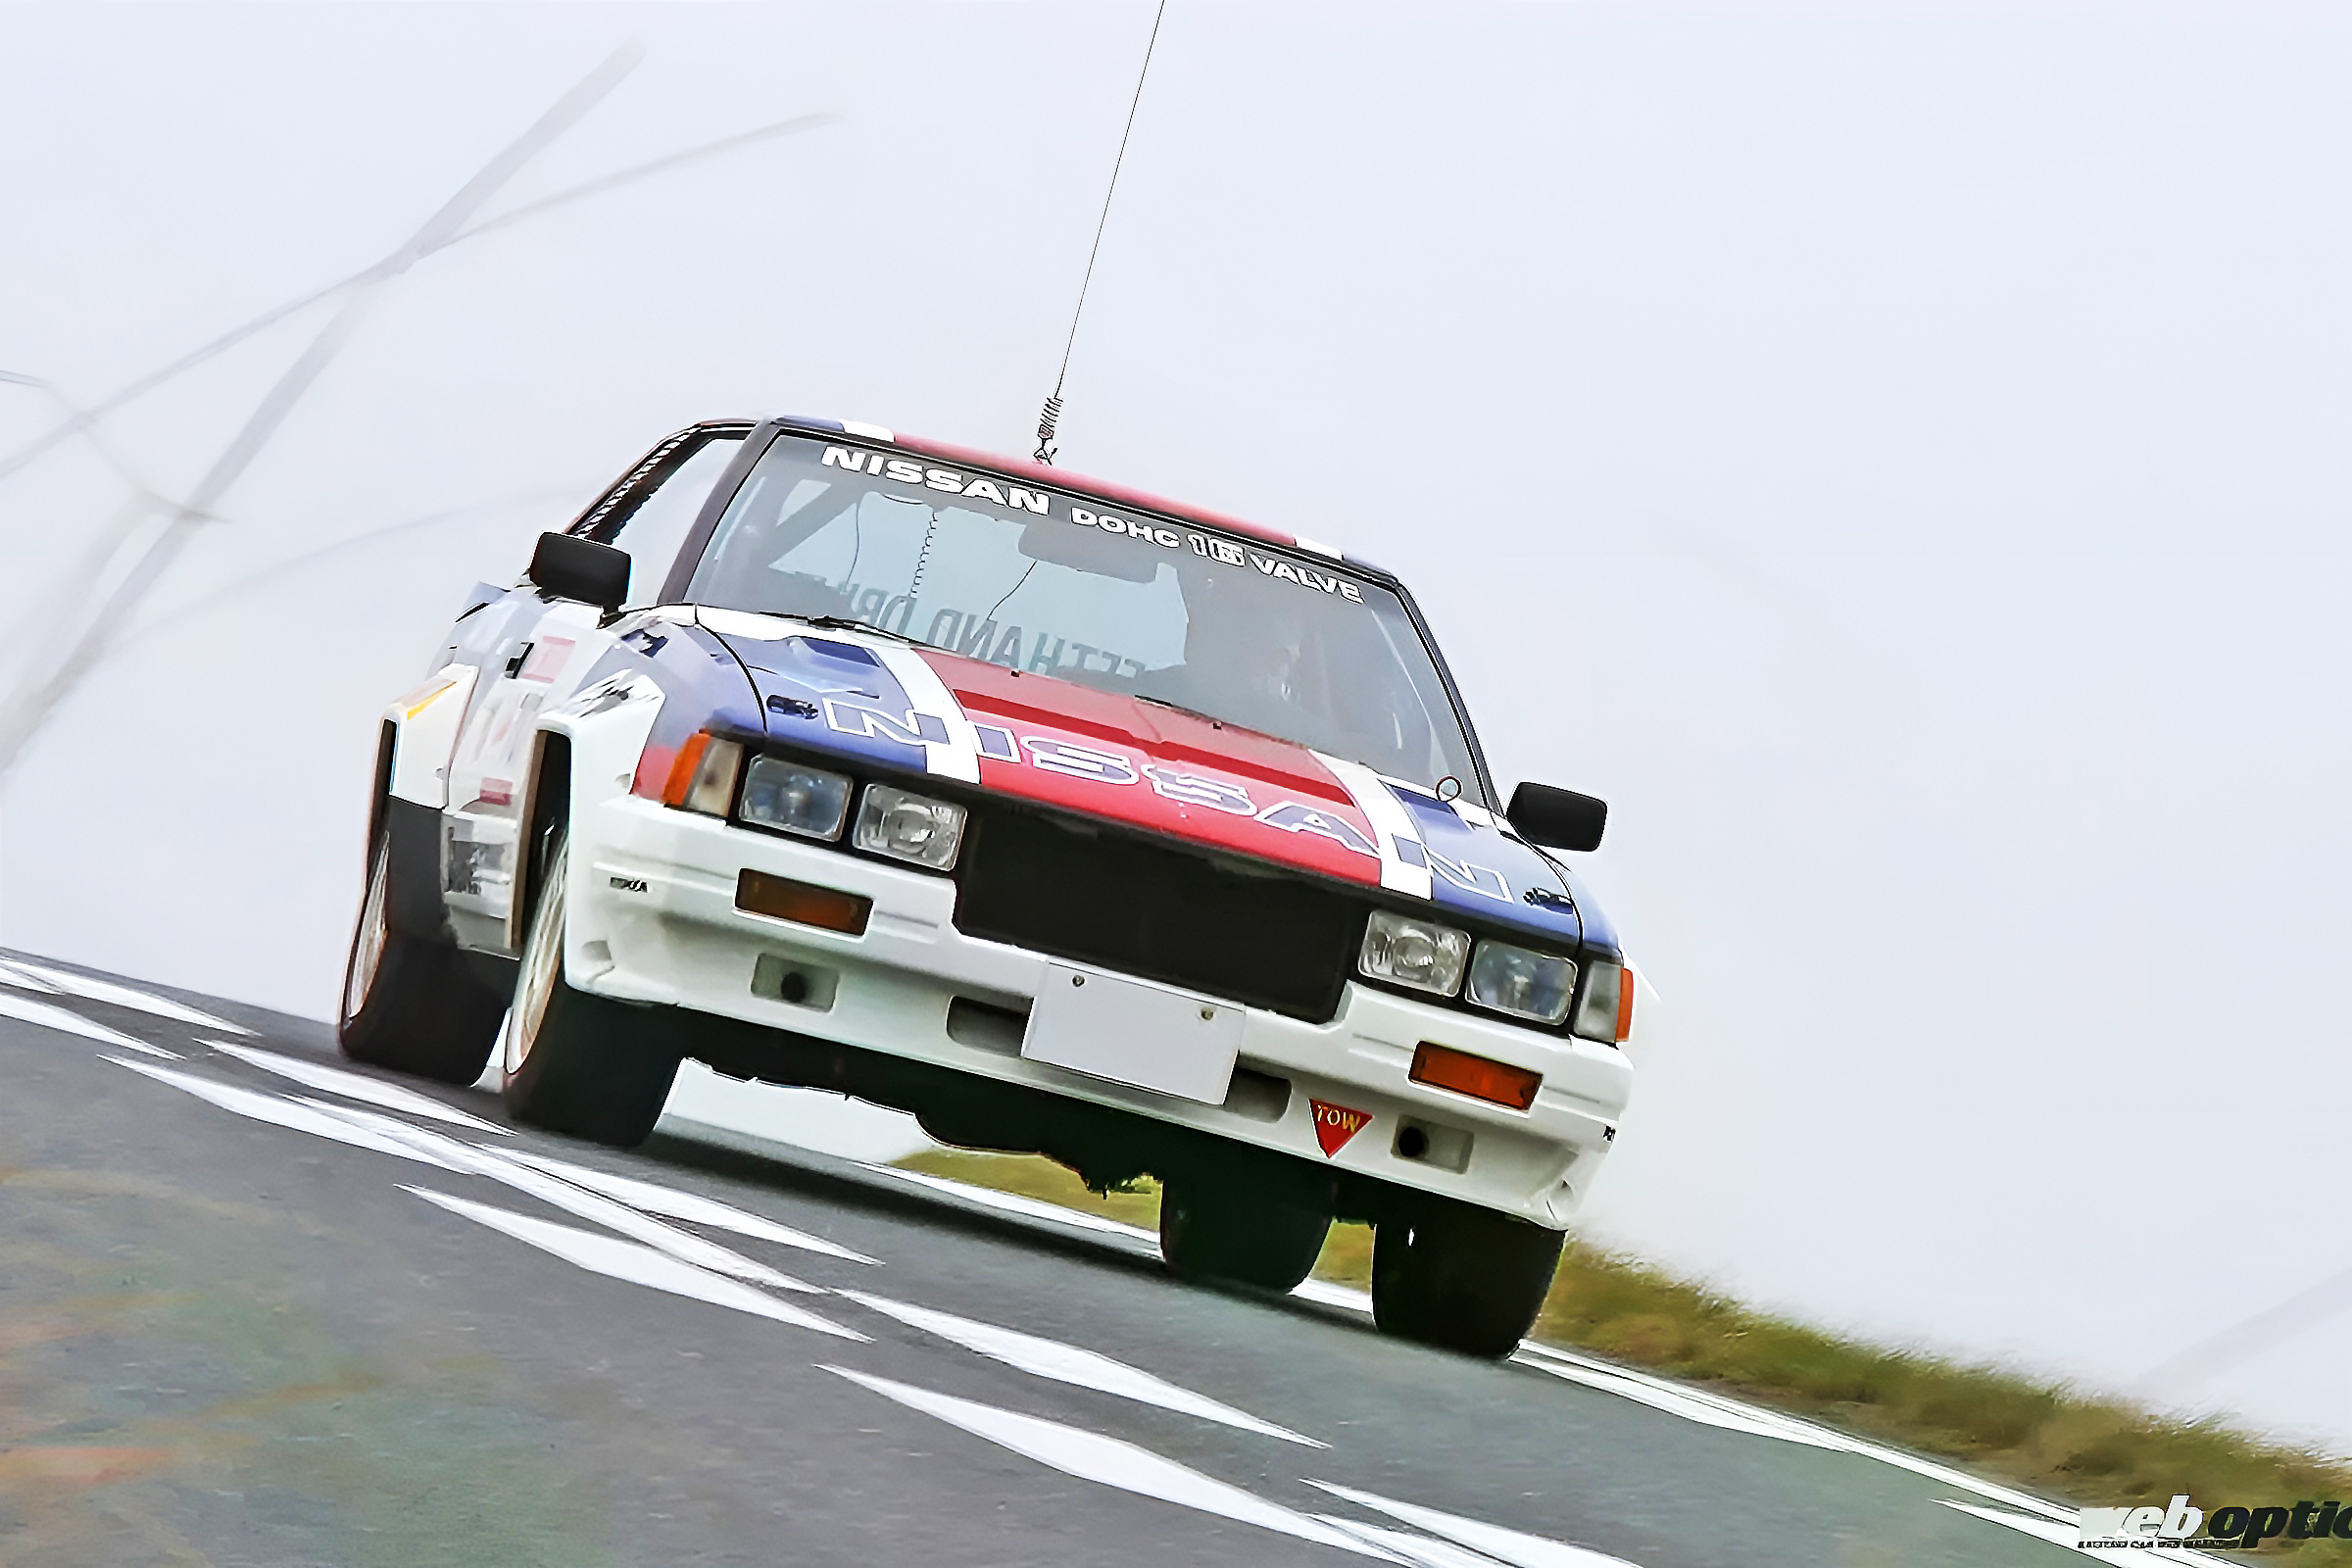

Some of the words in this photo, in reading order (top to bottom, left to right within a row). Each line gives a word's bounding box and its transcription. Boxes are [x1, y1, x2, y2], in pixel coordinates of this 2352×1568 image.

[821, 446, 1050, 515] NISSAN
[1071, 507, 1180, 548] DOHC
[1249, 553, 1365, 605] VALVE
[821, 697, 1515, 903] NISSAN
[1317, 1104, 1361, 1133] TOW
